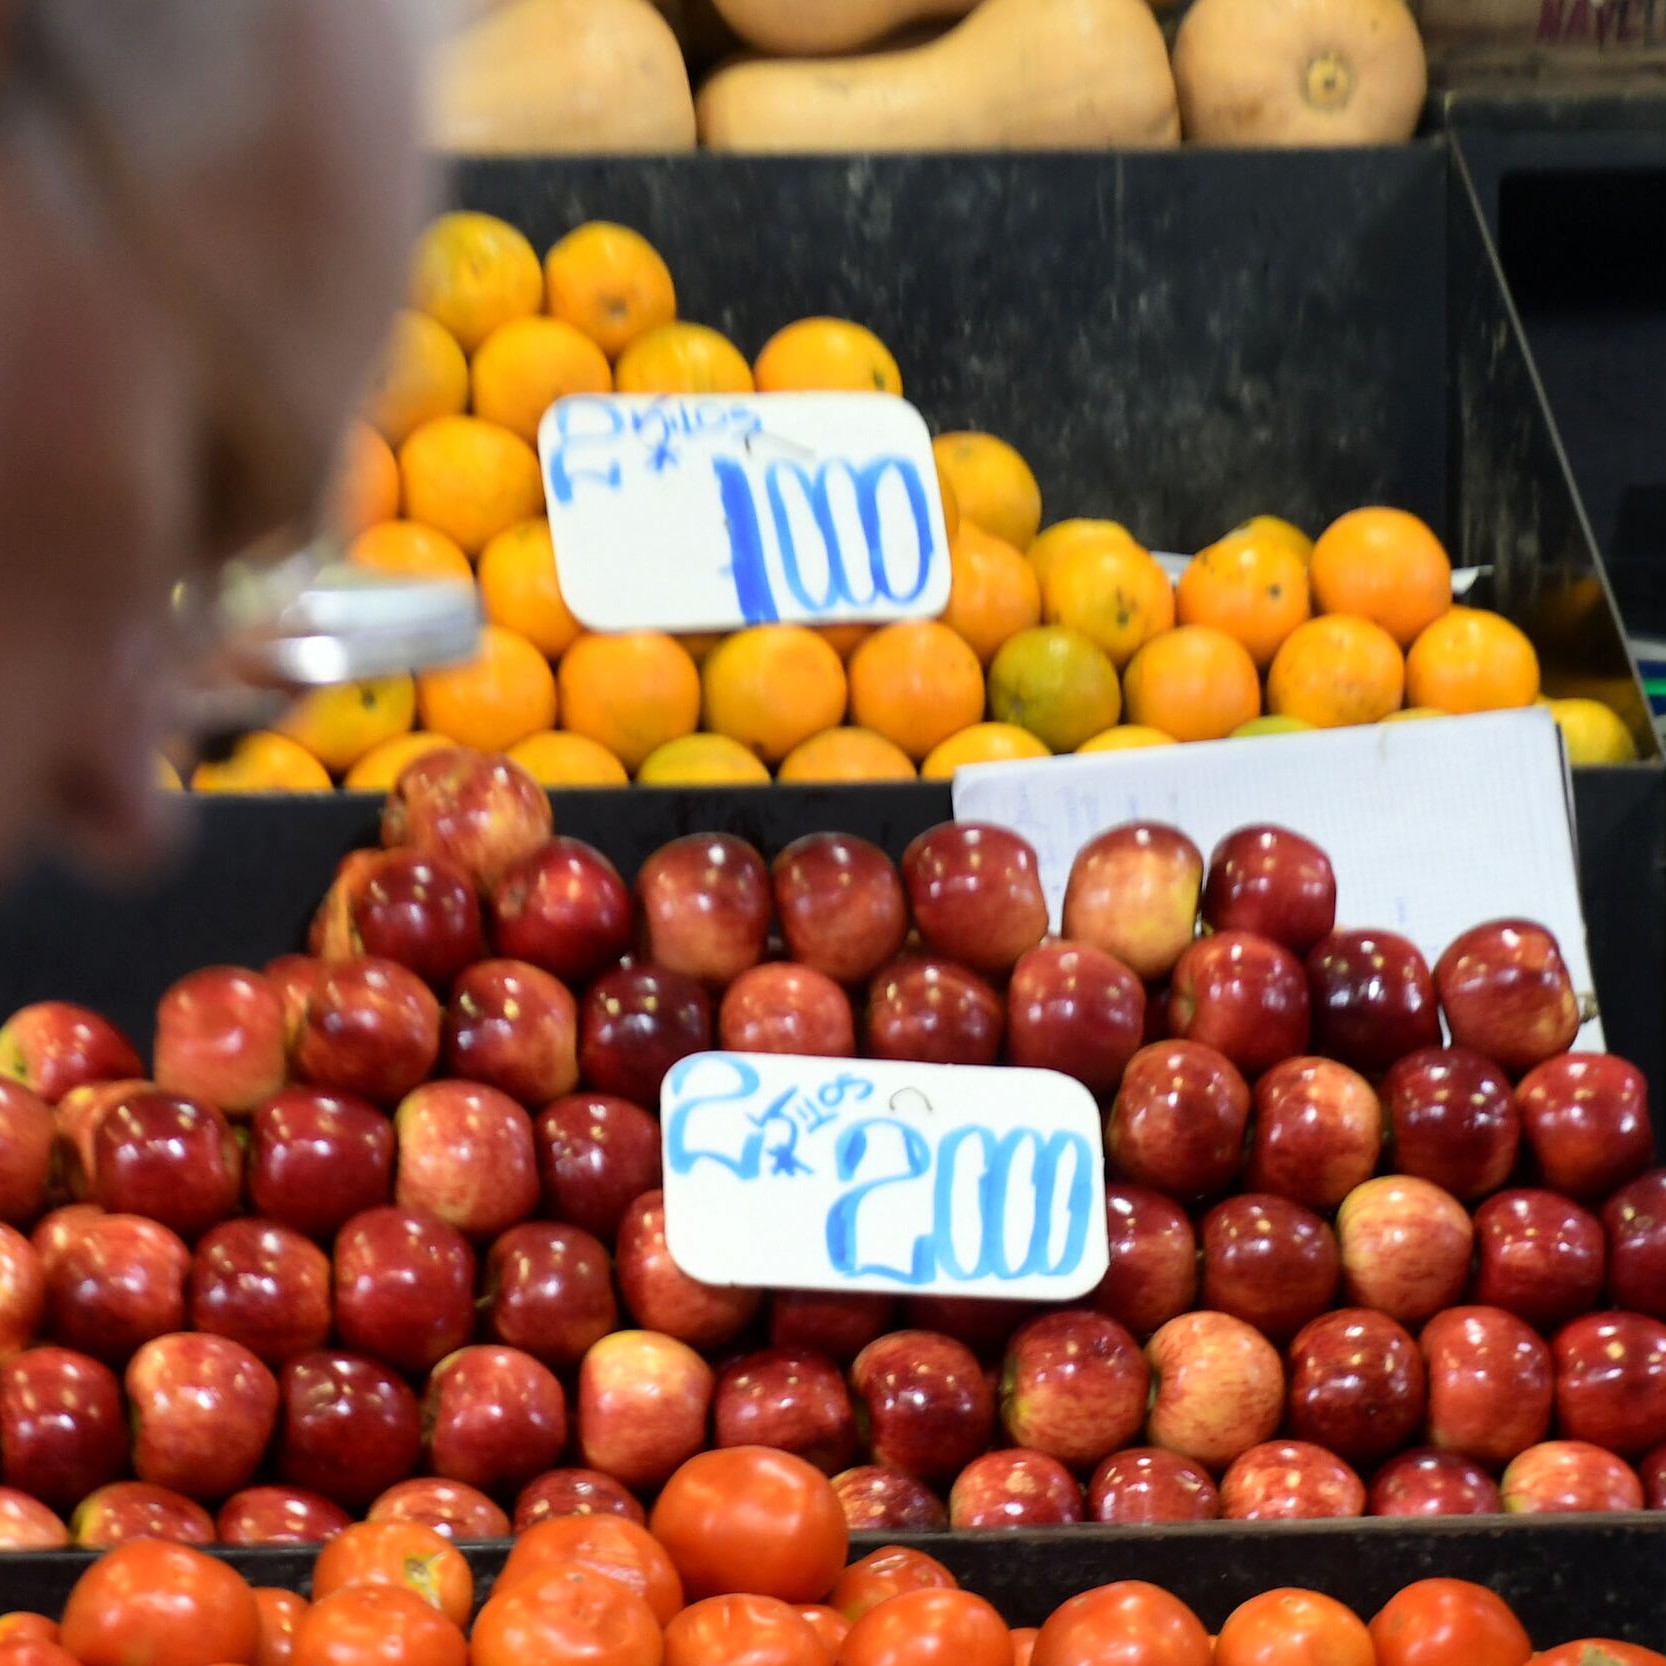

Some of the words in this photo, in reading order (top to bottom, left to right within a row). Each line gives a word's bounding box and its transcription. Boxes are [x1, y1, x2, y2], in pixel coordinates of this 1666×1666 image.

[550, 392, 624, 505] 2
[712, 453, 934, 625] 1000
[668, 1051, 762, 1180] 2
[826, 1118, 1093, 1285] 2000
